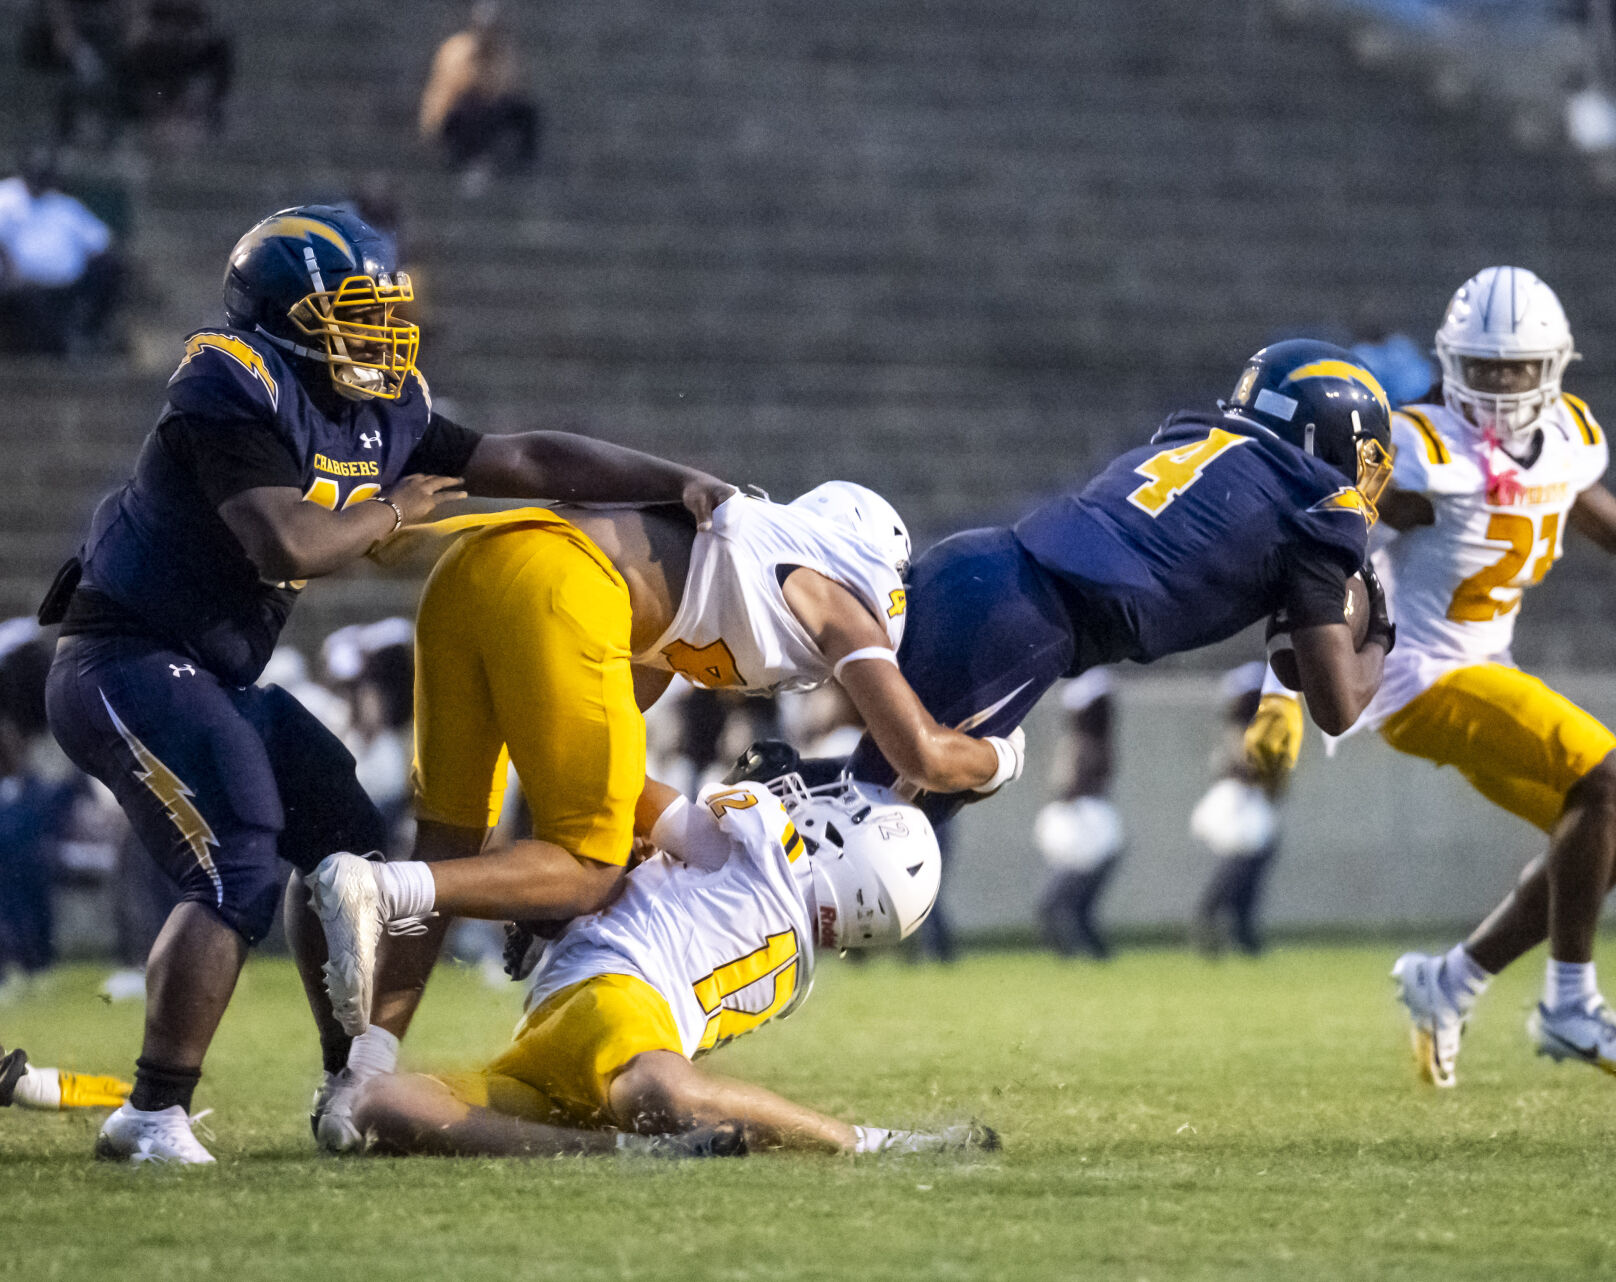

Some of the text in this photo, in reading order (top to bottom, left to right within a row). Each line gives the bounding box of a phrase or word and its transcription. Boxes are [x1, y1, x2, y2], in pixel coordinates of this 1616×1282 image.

[314, 453, 379, 477] CHARGERS
[1126, 427, 1251, 518] 4
[887, 589, 907, 619] 4
[705, 789, 759, 819] 12
[870, 811, 910, 840] 12
[692, 926, 800, 1050] 12
